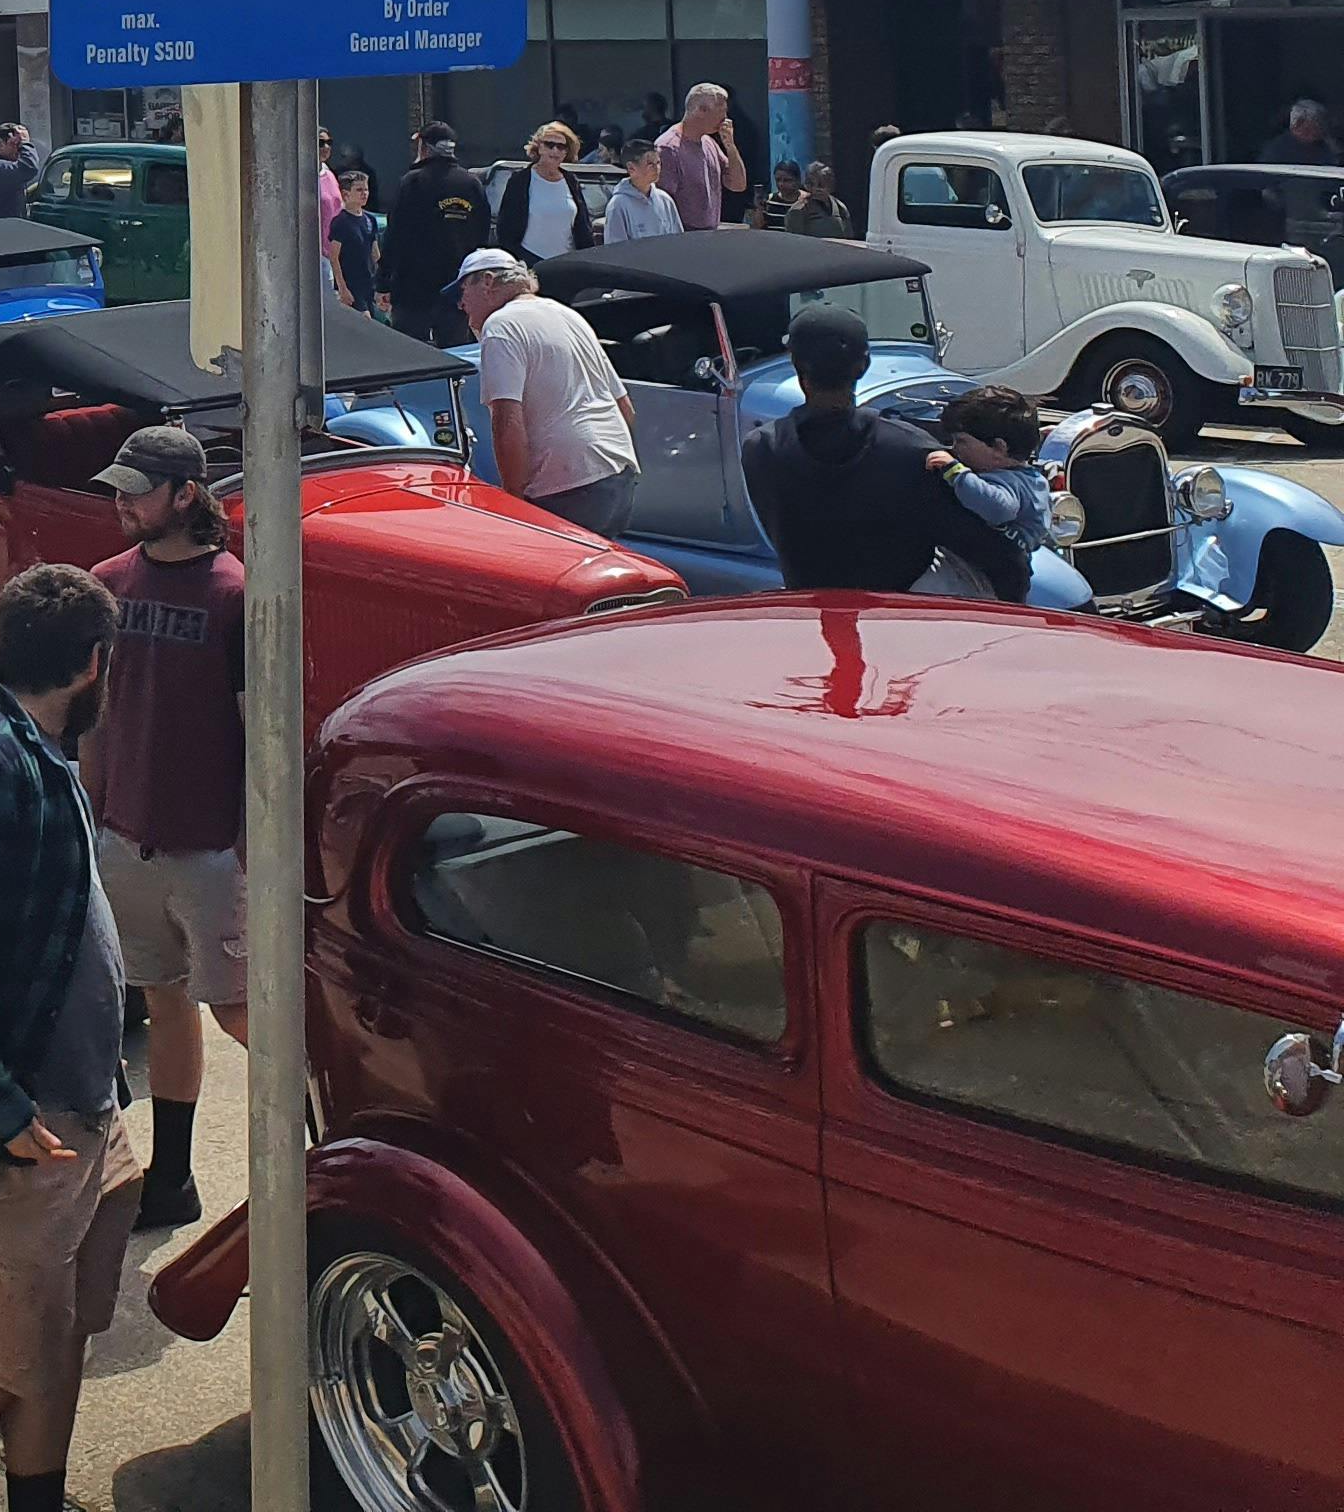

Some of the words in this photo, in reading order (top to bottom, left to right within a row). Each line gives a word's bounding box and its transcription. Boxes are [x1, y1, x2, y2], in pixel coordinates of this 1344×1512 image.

[121, 13, 160, 29] max.
[384, 0, 402, 22] By
[350, 30, 409, 53] General
[415, 29, 482, 52] Manager
[86, 42, 149, 66] Penalty
